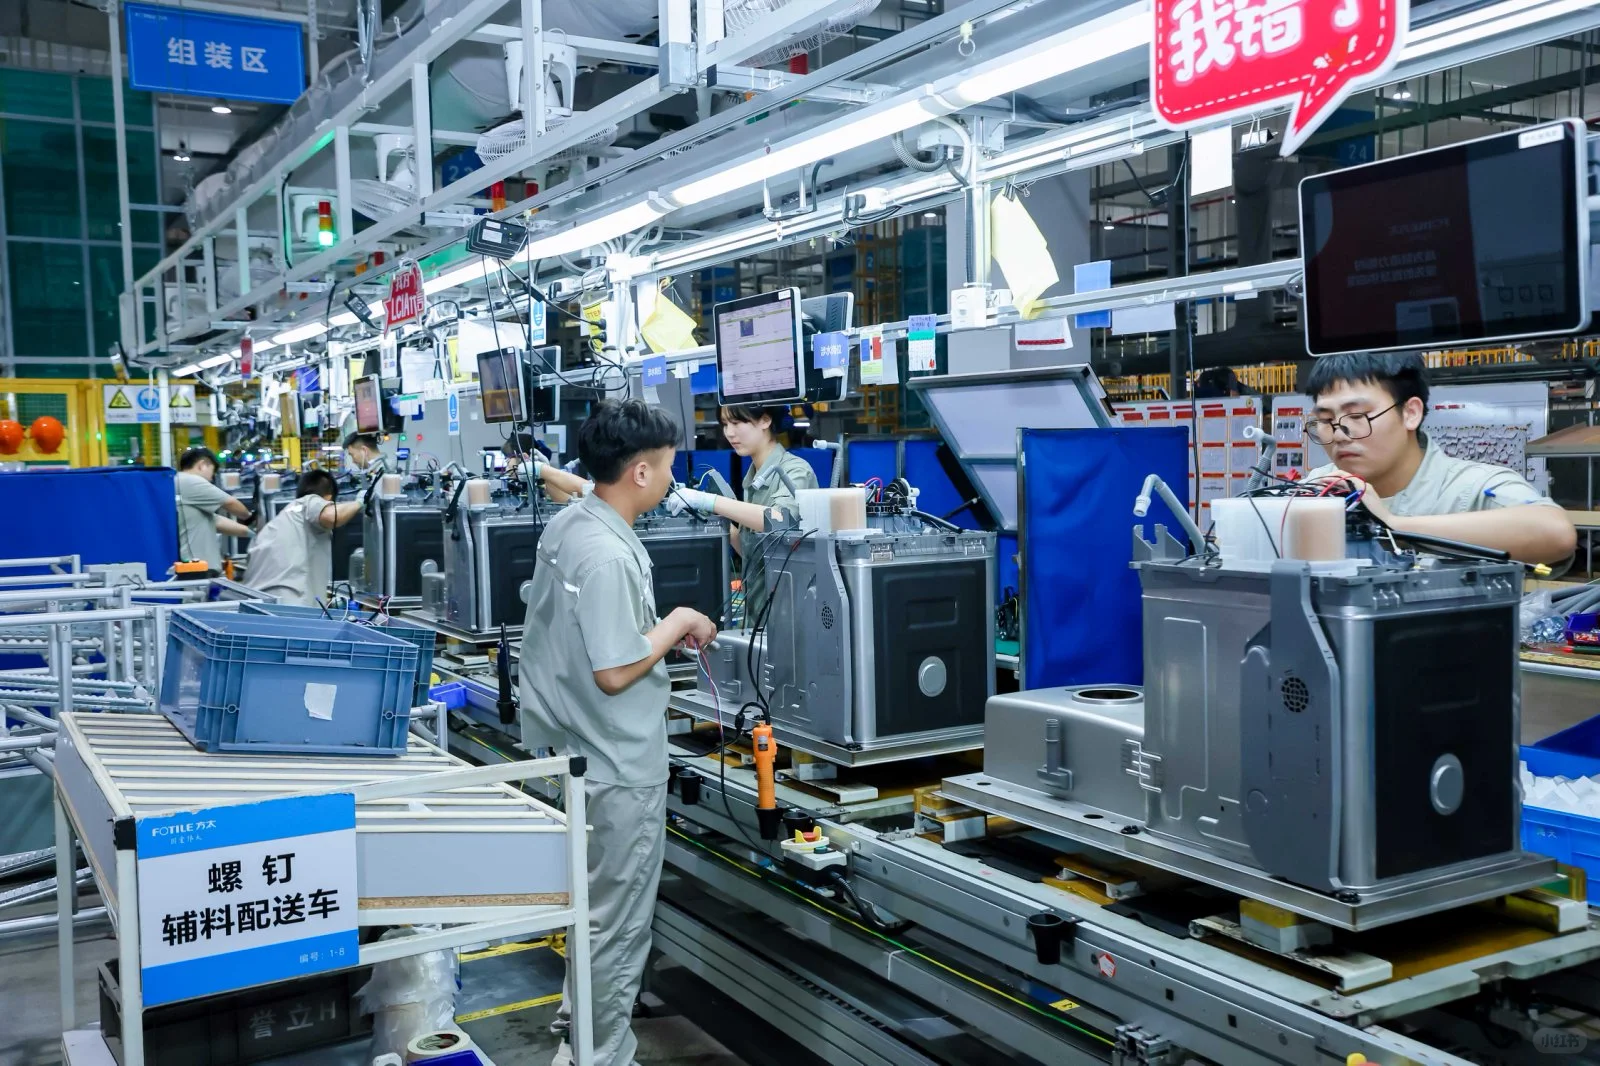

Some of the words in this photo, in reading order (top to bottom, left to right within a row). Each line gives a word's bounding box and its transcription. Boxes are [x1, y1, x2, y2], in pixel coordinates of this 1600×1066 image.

[167, 37, 269, 74] 组装区
[1349, 144, 1367, 160] 24
[152, 823, 194, 837] FOTILE
[195, 820, 217, 831] 方太
[207, 853, 296, 893] 螺钉
[162, 889, 340, 946] 辅料配送车
